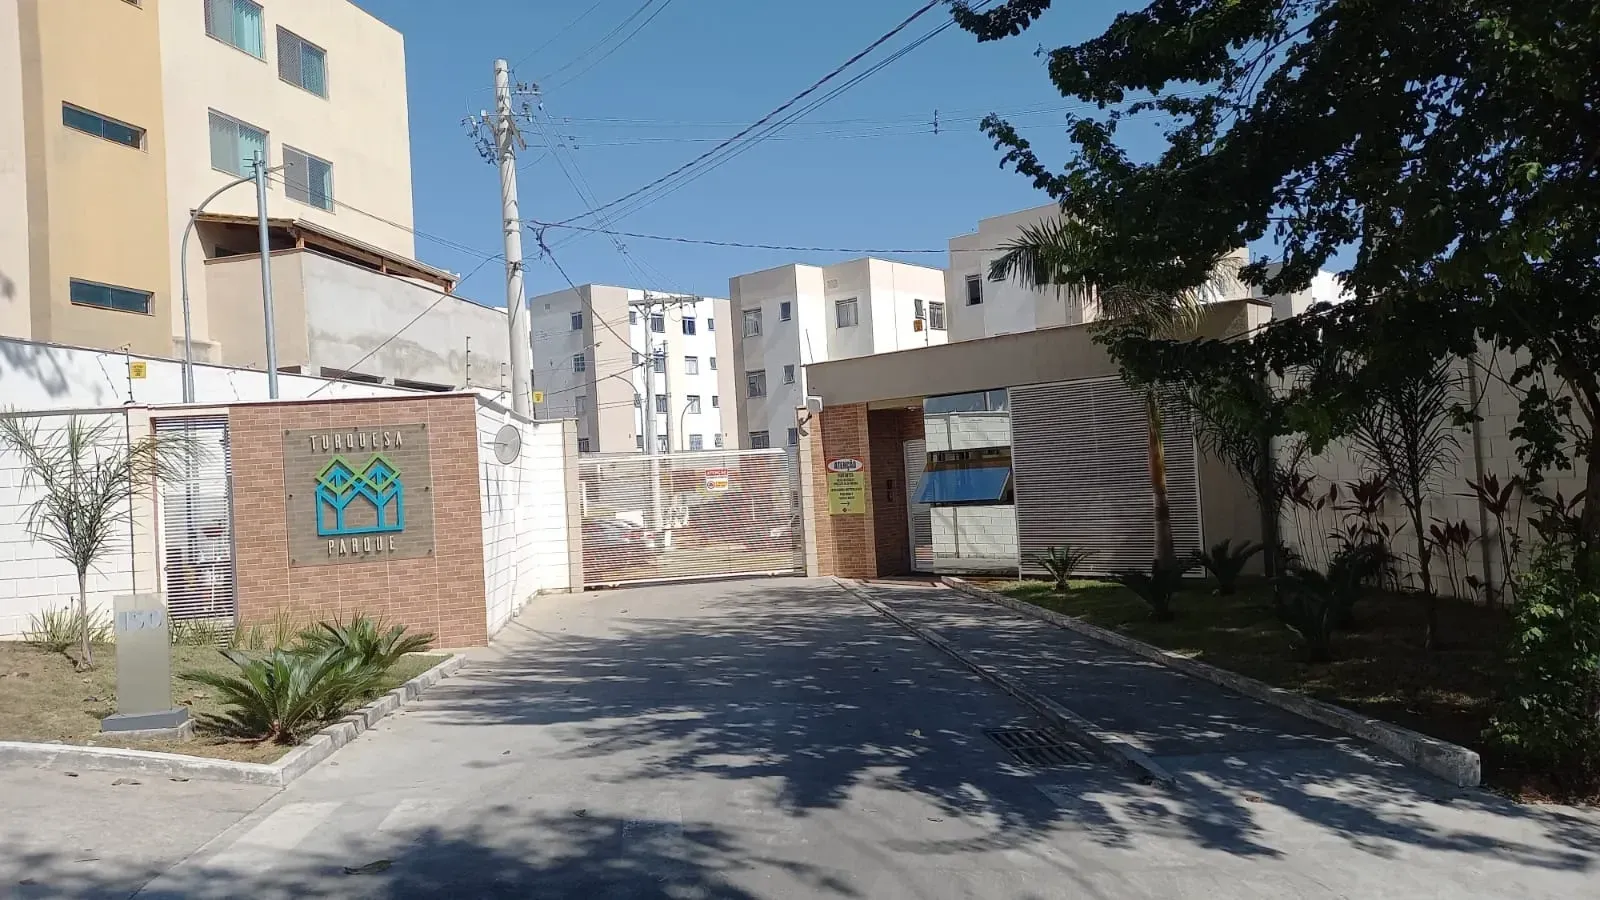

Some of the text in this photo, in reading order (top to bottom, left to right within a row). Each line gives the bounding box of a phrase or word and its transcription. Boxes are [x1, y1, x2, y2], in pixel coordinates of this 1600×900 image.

[310, 431, 403, 451] TURQUESA
[328, 535, 397, 555] PARQUE
[118, 611, 162, 631] 150
